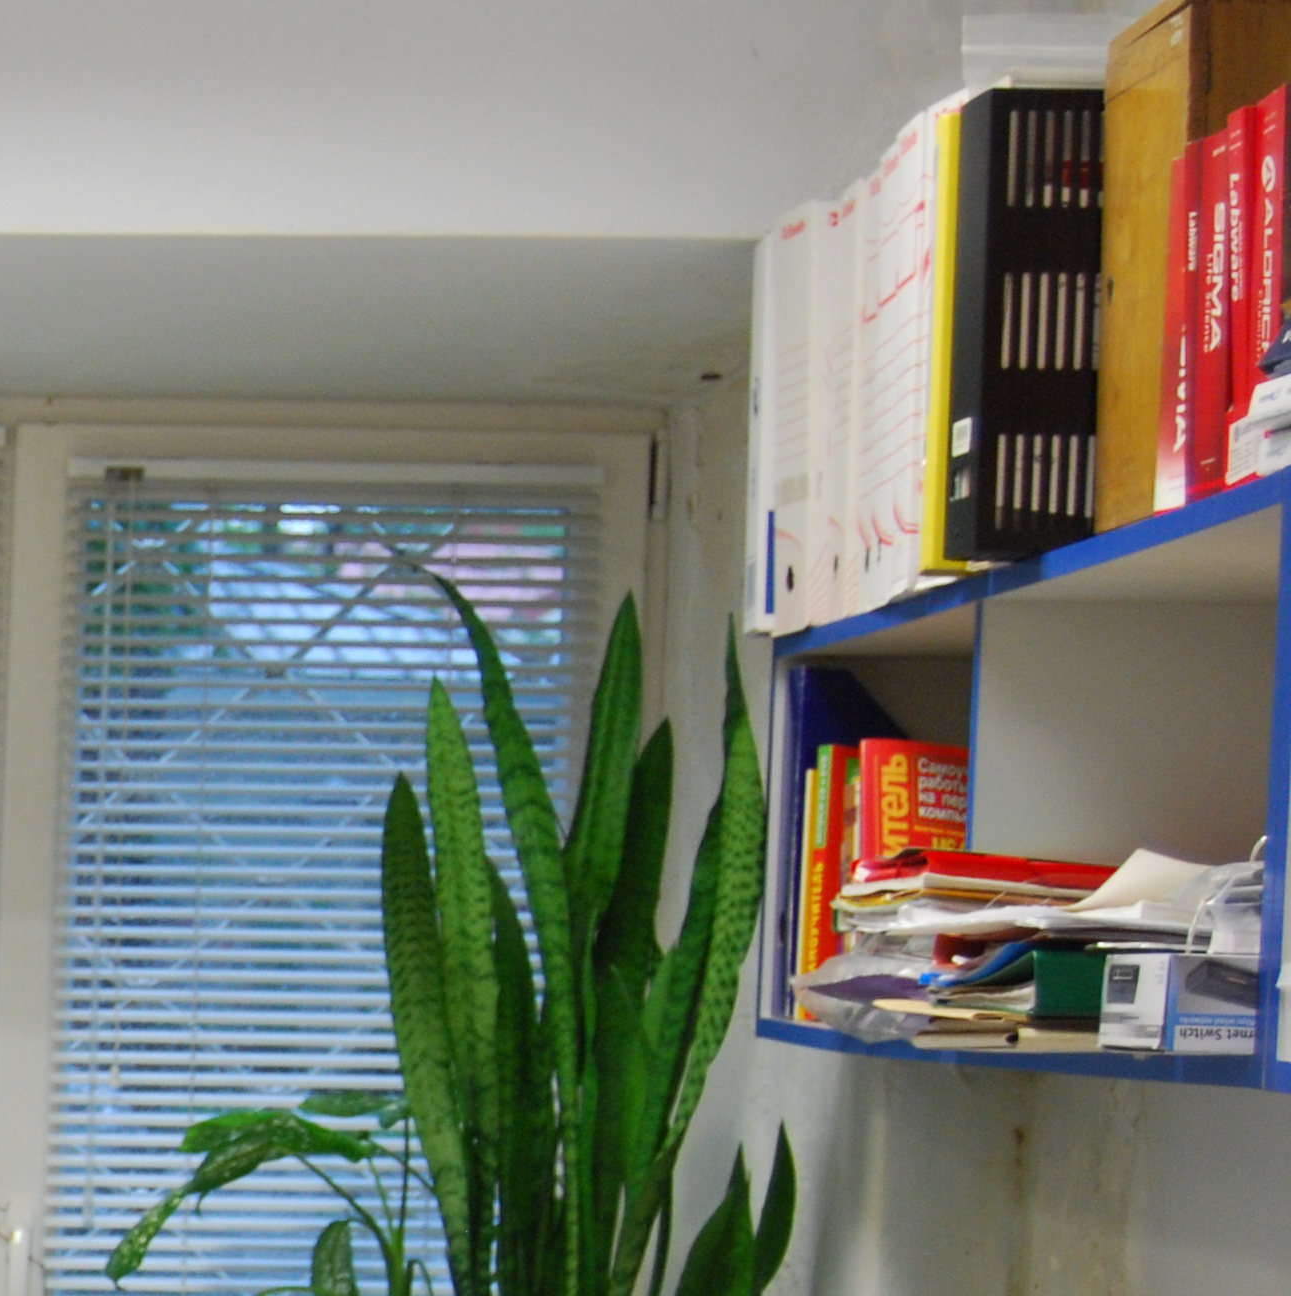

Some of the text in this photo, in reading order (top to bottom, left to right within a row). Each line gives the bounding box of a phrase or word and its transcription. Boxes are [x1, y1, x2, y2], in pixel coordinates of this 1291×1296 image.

[1188, 211, 1197, 271] Labware
[1210, 202, 1226, 351] SIGMA
[1229, 173, 1240, 302] Labware
[1179, 1028, 1221, 1041] Switch
